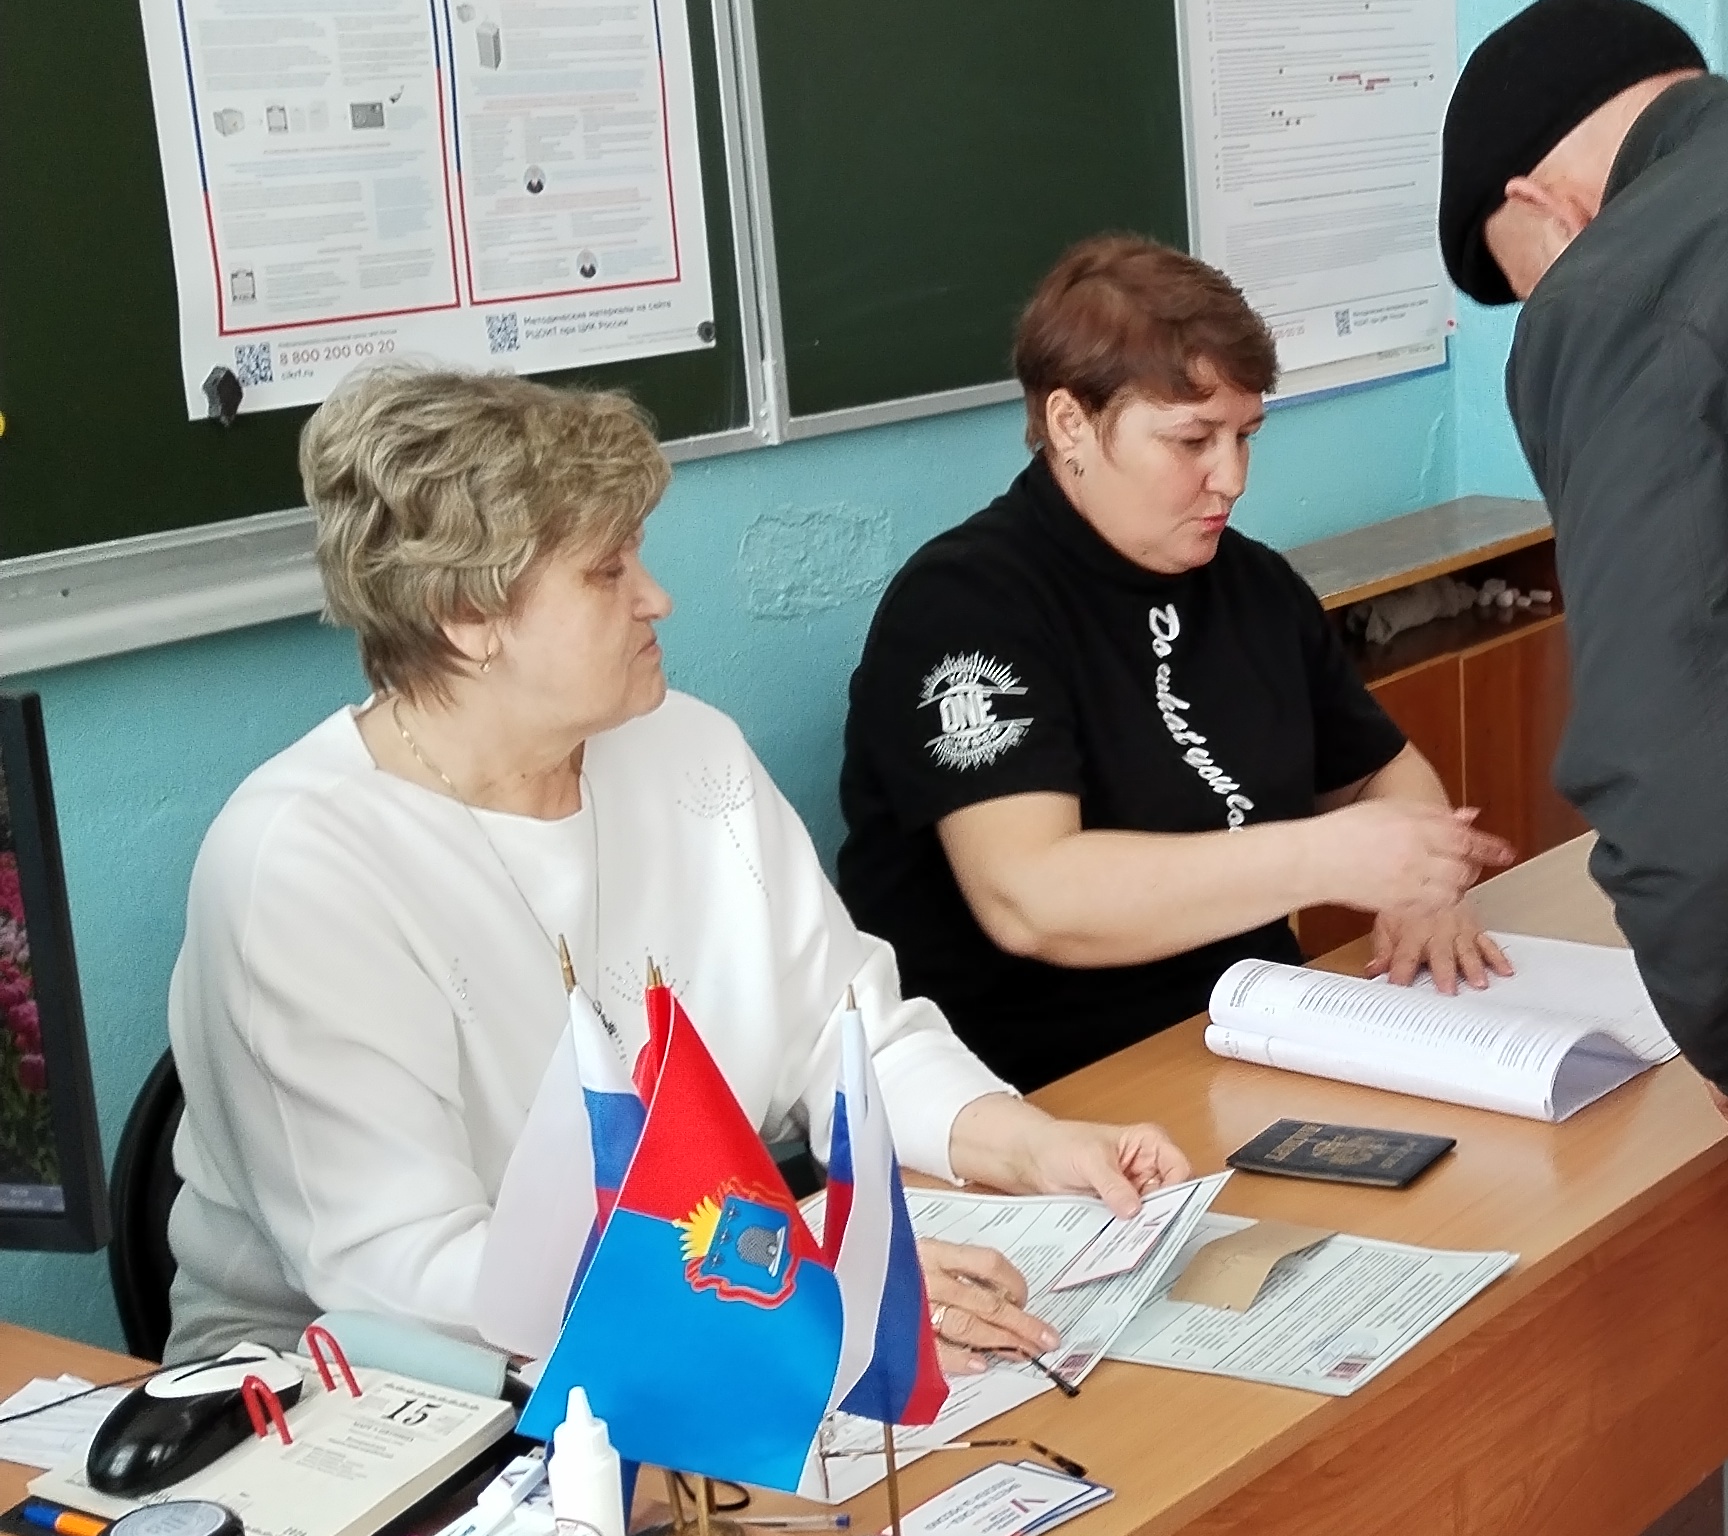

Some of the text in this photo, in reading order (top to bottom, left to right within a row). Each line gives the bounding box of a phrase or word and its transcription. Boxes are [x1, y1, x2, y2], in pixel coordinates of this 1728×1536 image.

[292, 348, 320, 365] 800
[324, 344, 351, 361] 200
[355, 341, 374, 357] 00
[377, 338, 395, 353] 20
[1149, 603, 1180, 658] Do
[380, 1397, 441, 1427] 15
